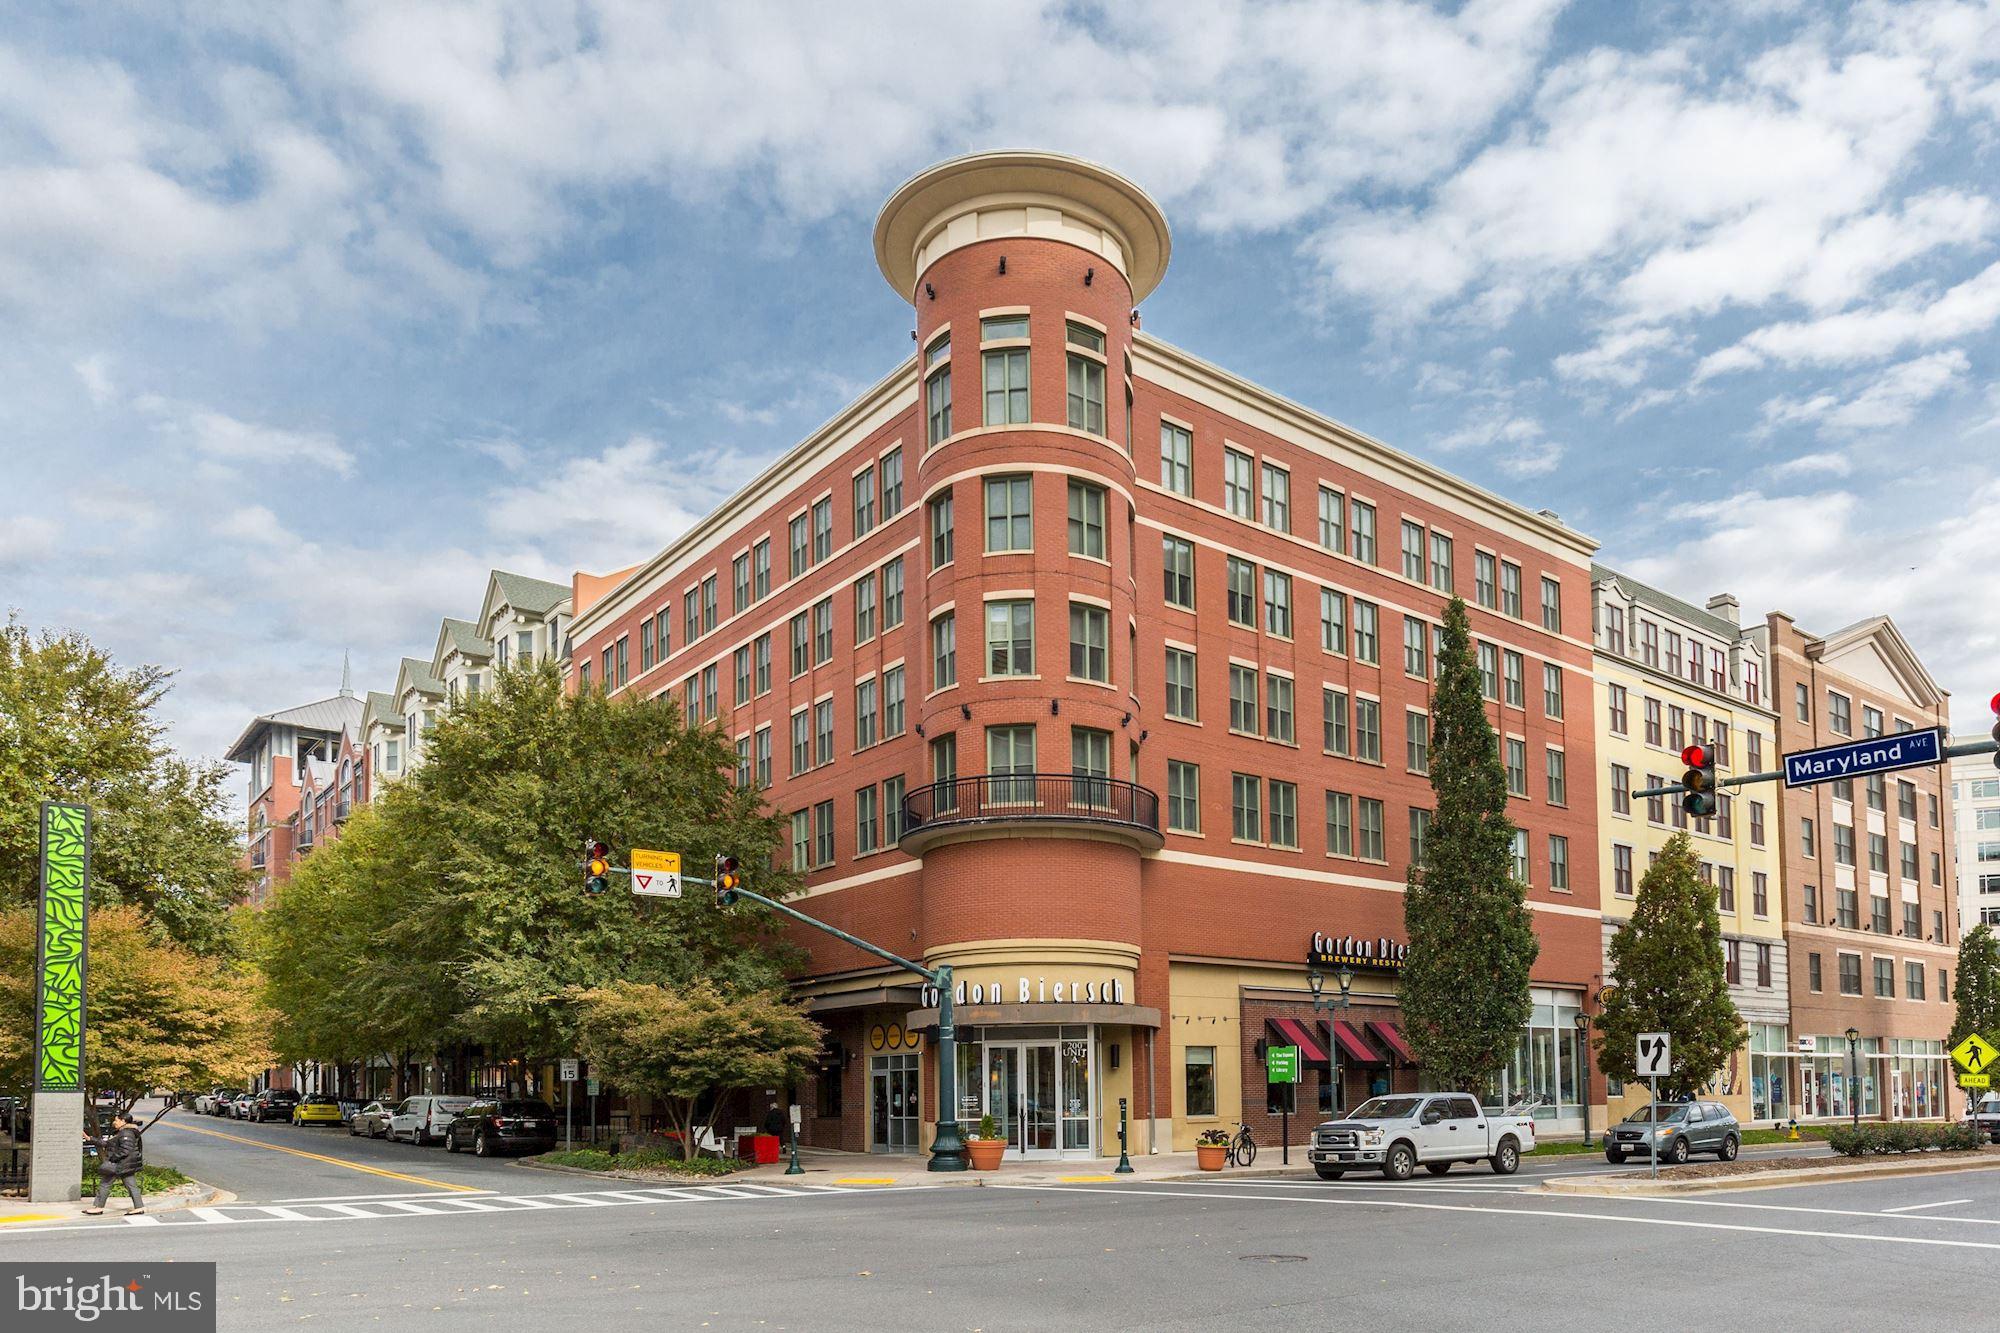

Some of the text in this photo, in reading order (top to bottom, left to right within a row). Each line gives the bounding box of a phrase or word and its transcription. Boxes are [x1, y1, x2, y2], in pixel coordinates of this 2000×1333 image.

[1794, 737, 1928, 776] Maryland AVE
[635, 853, 663, 861] TURNING
[1313, 931, 1372, 957] Gordon
[1321, 954, 1367, 965] BREWERY
[920, 977, 1124, 1008] Godon Biersch
[1063, 1048, 1087, 1057] UNIT
[1071, 1056, 1079, 1064] A
[563, 1070, 575, 1079] 15
